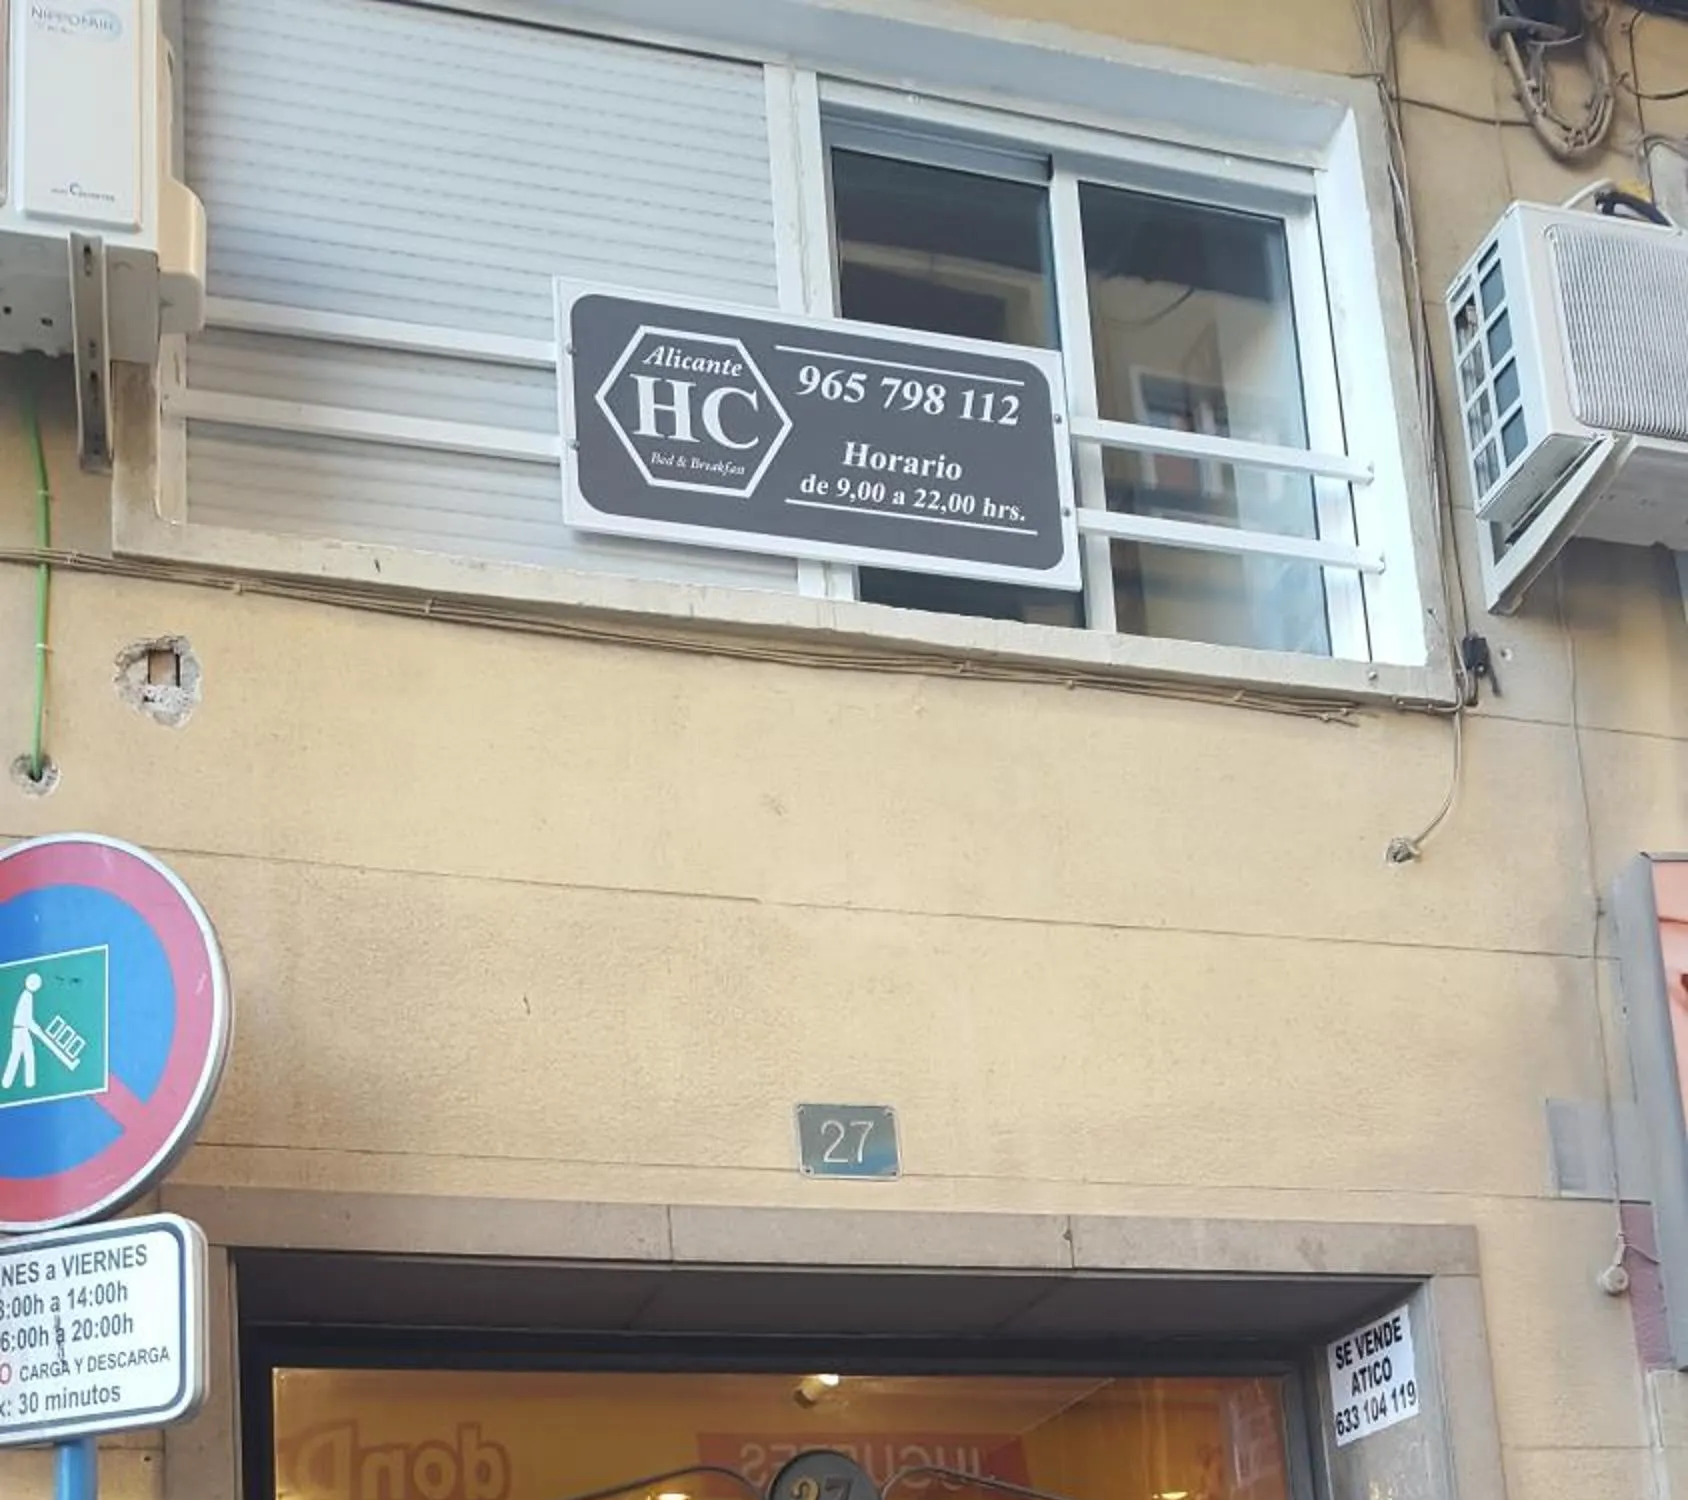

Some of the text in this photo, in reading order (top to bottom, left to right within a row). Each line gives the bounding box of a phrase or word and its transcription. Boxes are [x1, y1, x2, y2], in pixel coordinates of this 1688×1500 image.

[643, 343, 744, 378] Alicante
[629, 373, 760, 450] HC
[796, 365, 1020, 426] 965 798 112
[651, 451, 745, 477] Bed & Breakfast
[841, 441, 963, 481] Horario
[800, 473, 1026, 522] de 9,00 a 22,00 hrs.
[821, 1119, 874, 1164] 27
[46, 1264, 56, 1280] a
[62, 1243, 148, 1278] VIERNES
[50, 1296, 60, 1313] a
[68, 1280, 129, 1310] 14:00h
[56, 1327, 65, 1344] a
[72, 1313, 134, 1342] 20:00h
[1335, 1316, 1403, 1370] SE VENDE
[20, 1360, 70, 1382] CARGA
[75, 1357, 86, 1374] Y
[88, 1346, 171, 1373] DESCARGA
[1351, 1357, 1393, 1397] ATICO
[19, 1391, 39, 1415] 30
[45, 1384, 121, 1412] minutos
[1336, 1380, 1417, 1436] 633 104 119
